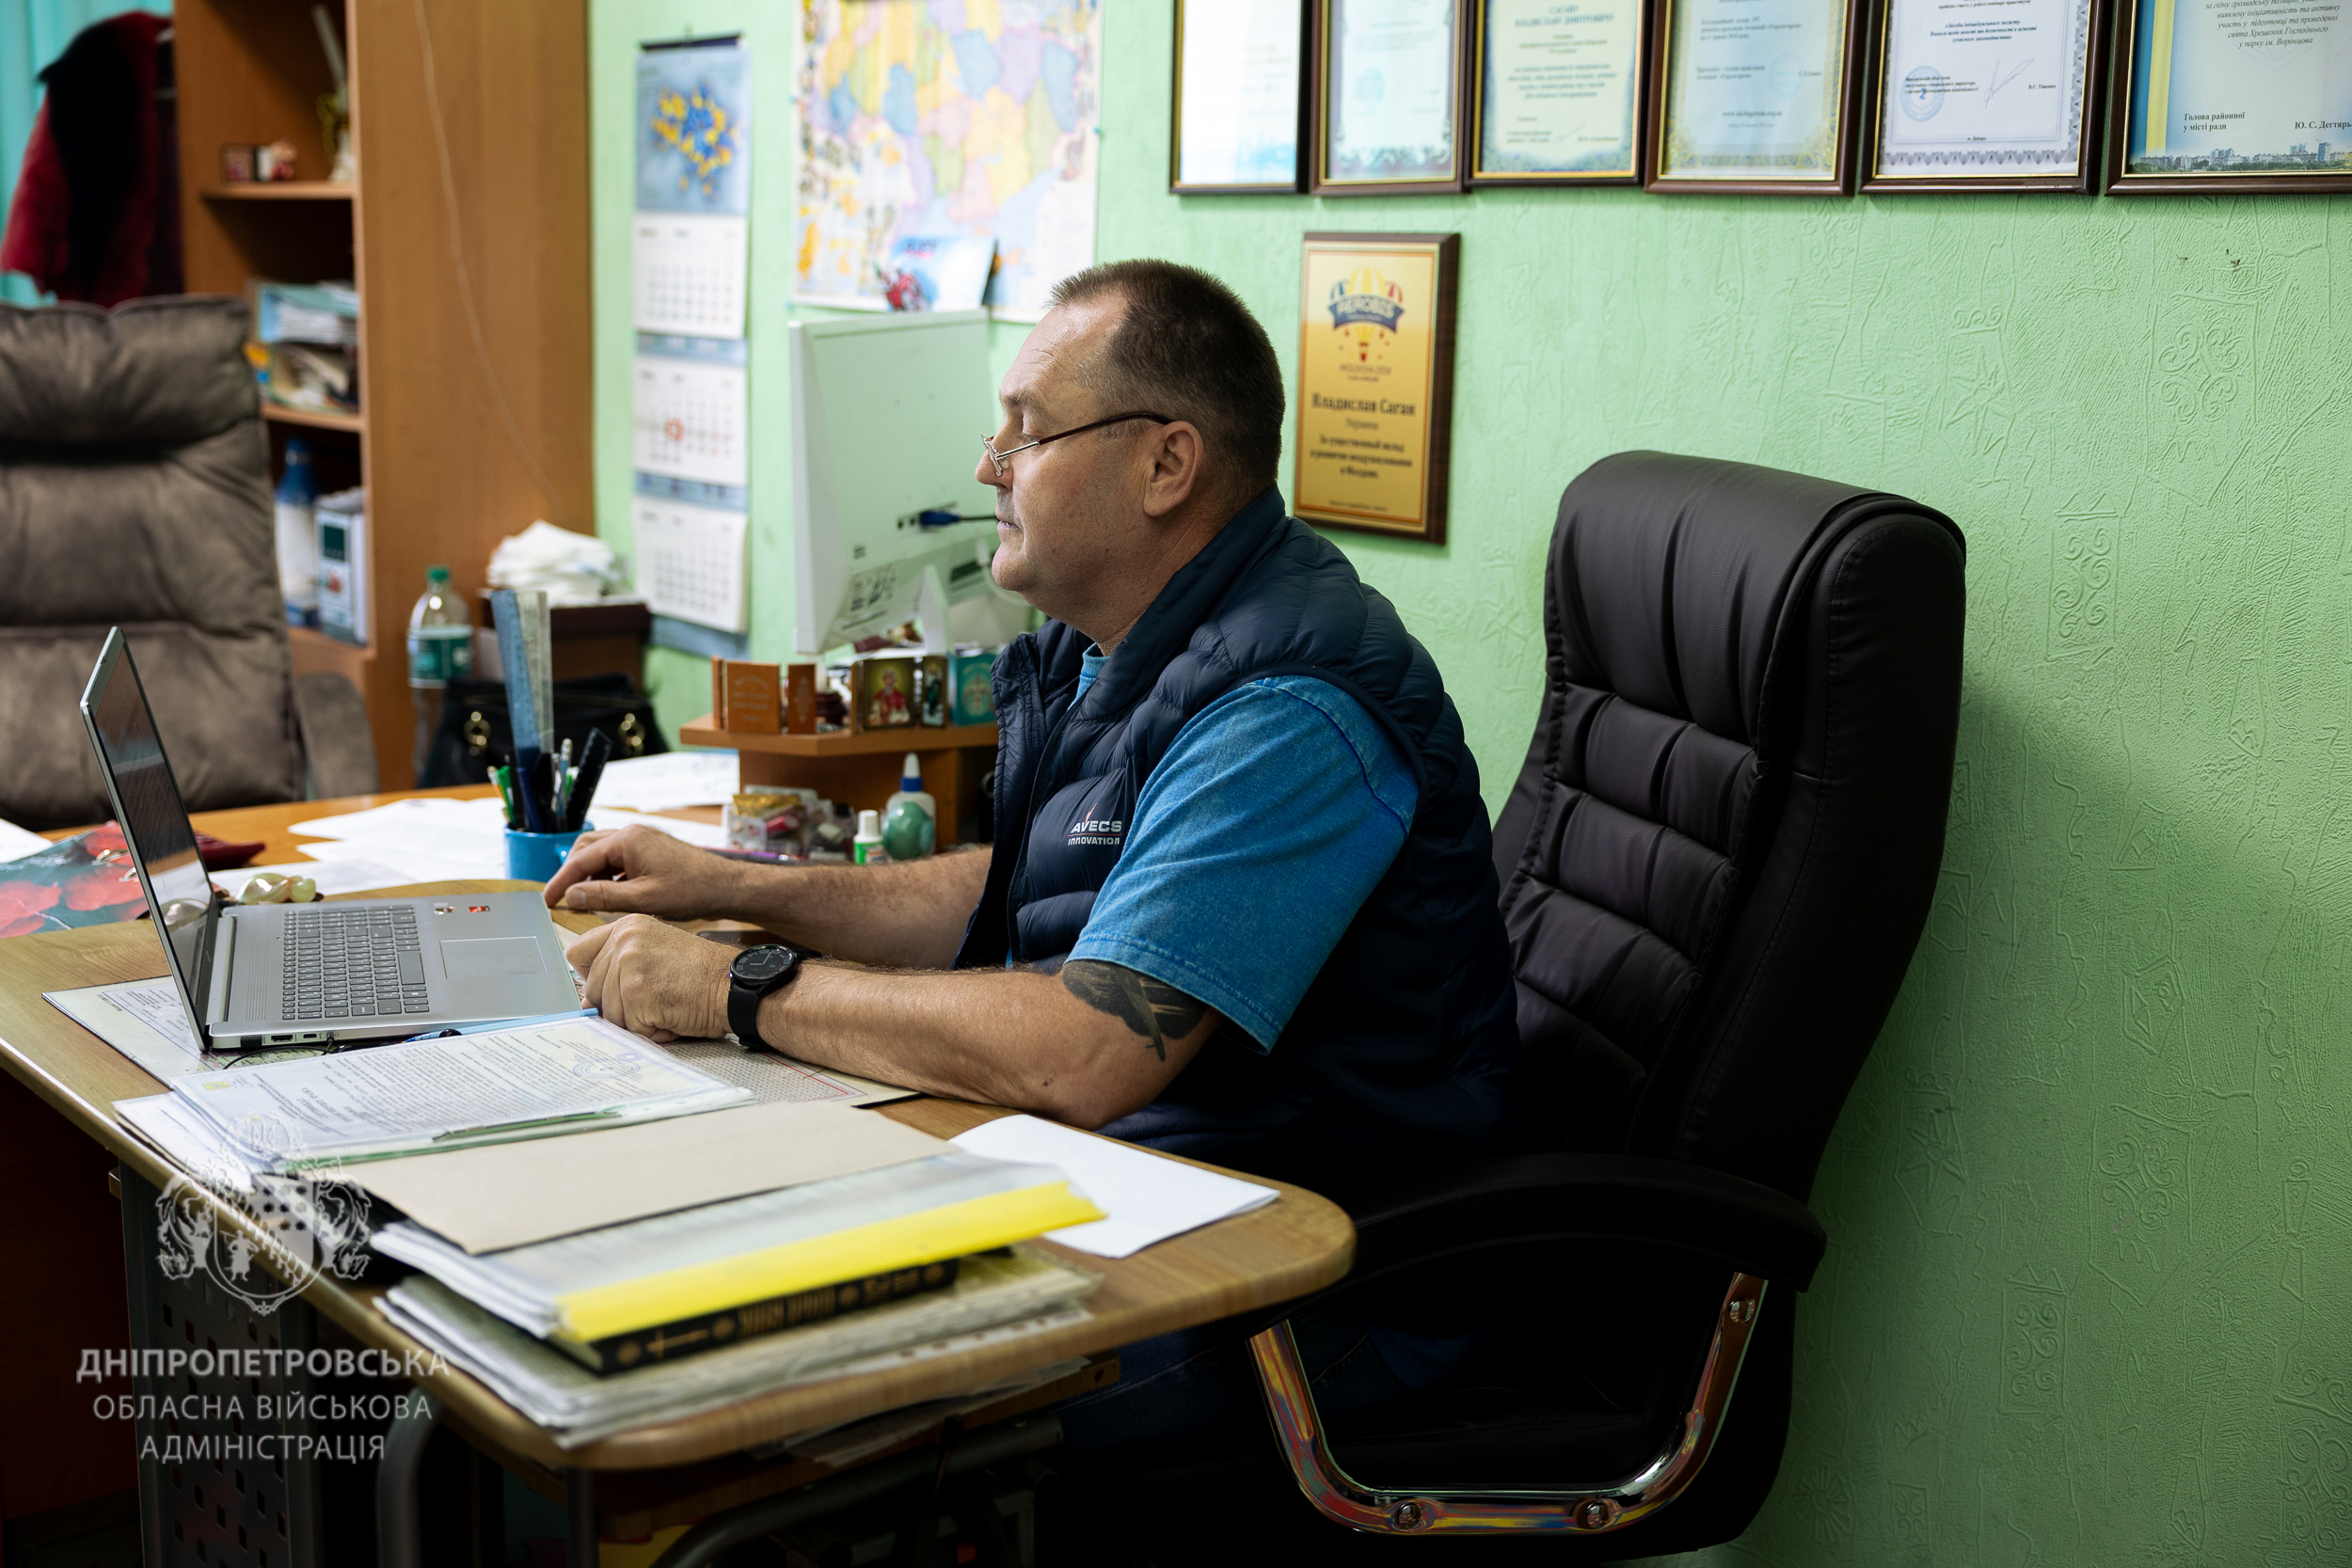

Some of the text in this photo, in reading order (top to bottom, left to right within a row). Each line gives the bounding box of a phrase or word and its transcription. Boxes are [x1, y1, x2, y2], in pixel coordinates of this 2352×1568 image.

[2247, 8, 2298, 17] ініціативність
[2311, 4, 2342, 12] активну
[2217, 22, 2242, 31] участь
[2249, 17, 2288, 27] підготовці
[2300, 13, 2339, 25] проведенні
[2249, 27, 2283, 39] Хрещення
[2284, 25, 2328, 36] Господнього
[2237, 41, 2244, 50] у
[2244, 40, 2265, 49] парку
[2276, 37, 2313, 46] Воронцова
[2184, 111, 2246, 122] Голова районної
[2183, 122, 2227, 133] у місті ради
[2294, 120, 2352, 131] Ю. С. Дегтярь
[1311, 391, 1417, 417] Владислав Саган
[1070, 820, 1122, 833] AVECS
